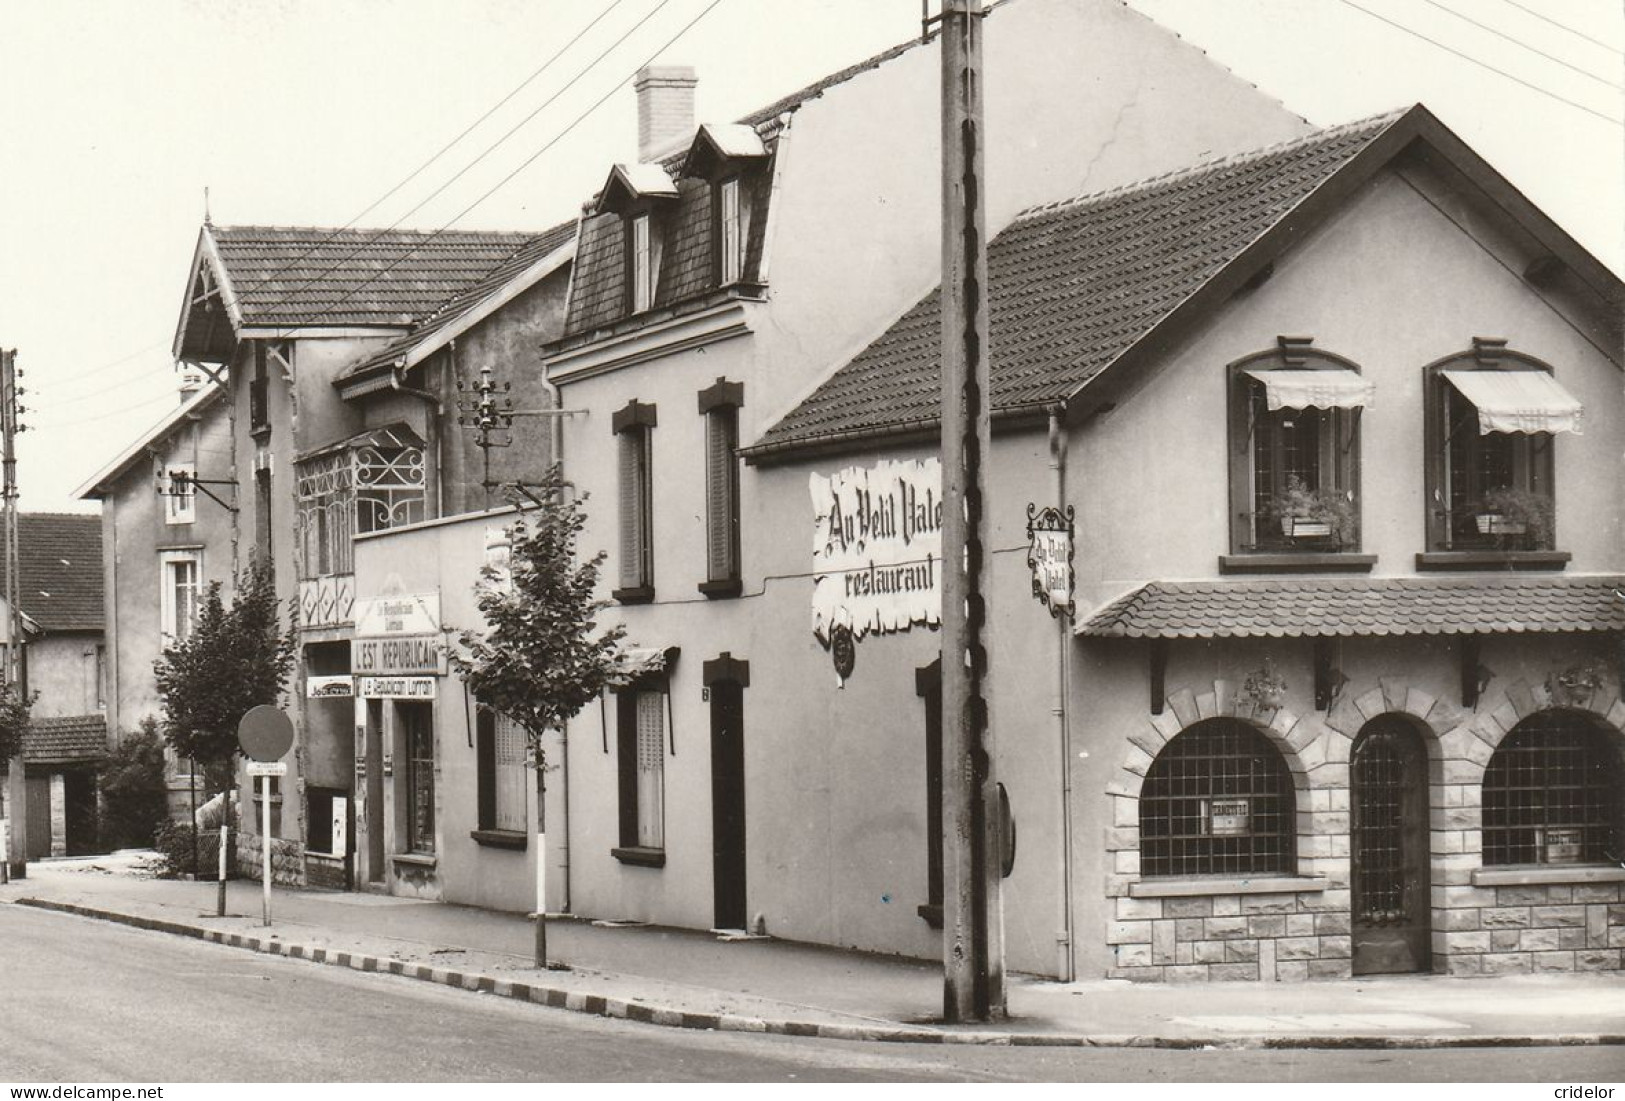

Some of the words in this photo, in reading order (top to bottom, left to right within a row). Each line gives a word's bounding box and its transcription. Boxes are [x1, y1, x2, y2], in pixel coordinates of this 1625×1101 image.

[825, 490, 855, 555] Au
[855, 485, 897, 556] Petit
[899, 475, 942, 546] Vale
[845, 552, 934, 598] restaurant
